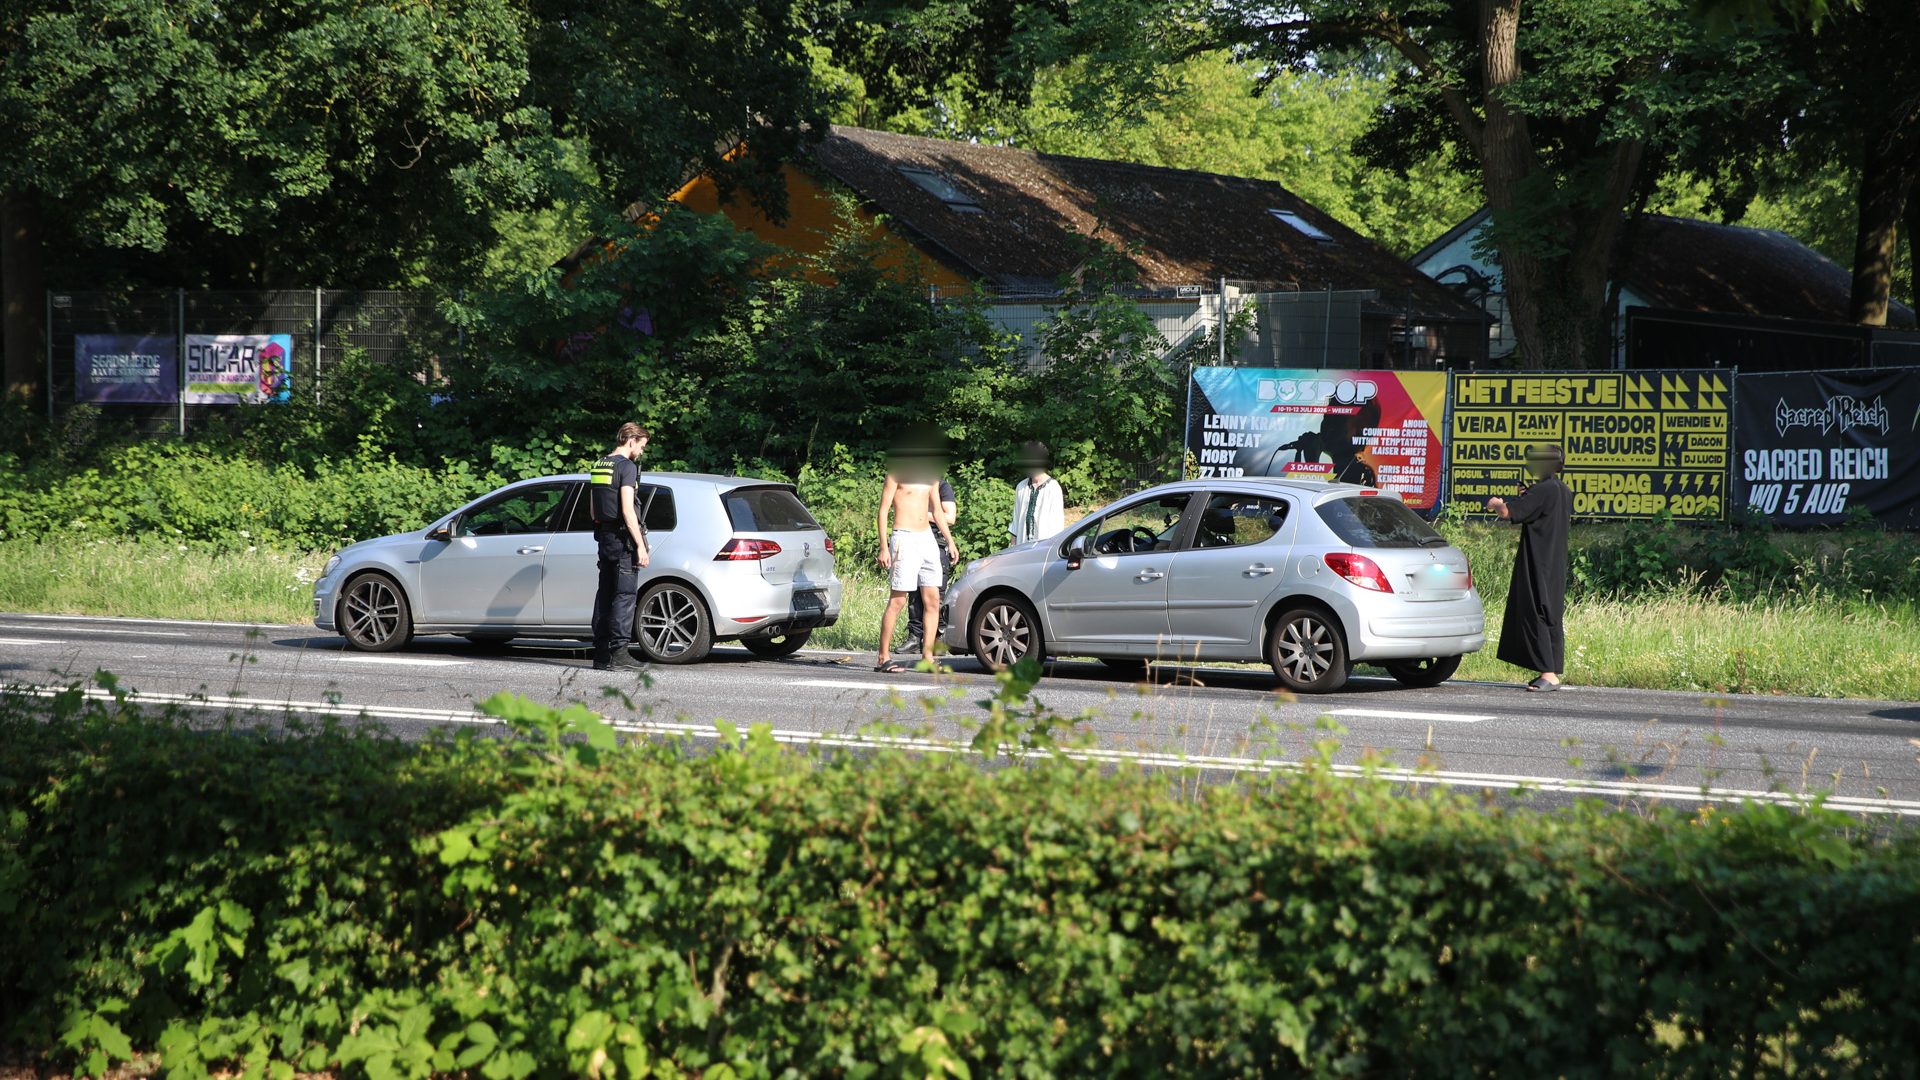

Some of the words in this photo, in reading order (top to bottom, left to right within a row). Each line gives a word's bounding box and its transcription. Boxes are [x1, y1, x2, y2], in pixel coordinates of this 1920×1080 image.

[188, 343, 256, 373] SOLAR
[1257, 378, 1378, 405] BOSPOP
[1458, 378, 1507, 404] HET
[1510, 378, 1618, 405] FEESTJE
[1203, 414, 1248, 430] LENNY
[1402, 419, 1428, 428] ANOUK
[1457, 415, 1507, 433] VE/RA
[1518, 414, 1559, 430] ZANY
[1666, 416, 1711, 428] WENDIE
[1713, 416, 1724, 428] V.
[1775, 395, 1835, 438] Sacred
[1835, 394, 1890, 437] Reich
[1362, 428, 1400, 437] COUNTING
[1401, 428, 1428, 437] CROWS
[1569, 415, 1656, 434] THEODOR
[1203, 431, 1262, 448] VOLBEAT
[1352, 436, 1379, 446] WITHIN
[1380, 437, 1427, 447] TEMPTATION
[1568, 436, 1657, 455] NABUURS
[1201, 448, 1237, 465] MOBY
[1372, 446, 1399, 455] KAISER
[1400, 447, 1427, 456] CHIEFS
[1456, 444, 1500, 460] HANS
[1684, 454, 1696, 464] DJ
[1697, 454, 1723, 464] LUCID
[1290, 463, 1296, 471] 3
[1297, 464, 1325, 472] DAGEN
[1378, 464, 1400, 474] CHRIS
[1401, 465, 1425, 474] ISAAK
[1409, 457, 1426, 465] OMD
[1744, 448, 1823, 481] SACRED
[1829, 447, 1888, 480] REICH
[1199, 465, 1216, 478] ZZ
[1218, 466, 1244, 478] TOP
[1377, 474, 1425, 484] KENSINGTON
[1454, 470, 1484, 479] BOSUIL
[1490, 470, 1519, 480] WEERT
[1381, 484, 1424, 494] AIRBOURNE
[1454, 484, 1488, 496] BOILER
[1489, 485, 1518, 496] ROOM
[1561, 473, 1651, 494] ATERDAG
[1573, 493, 1666, 514] OKTOBER
[1669, 494, 1720, 516] 2026
[1749, 483, 1783, 515] WO
[1783, 483, 1804, 515] 5
[1801, 482, 1850, 515] AUG
